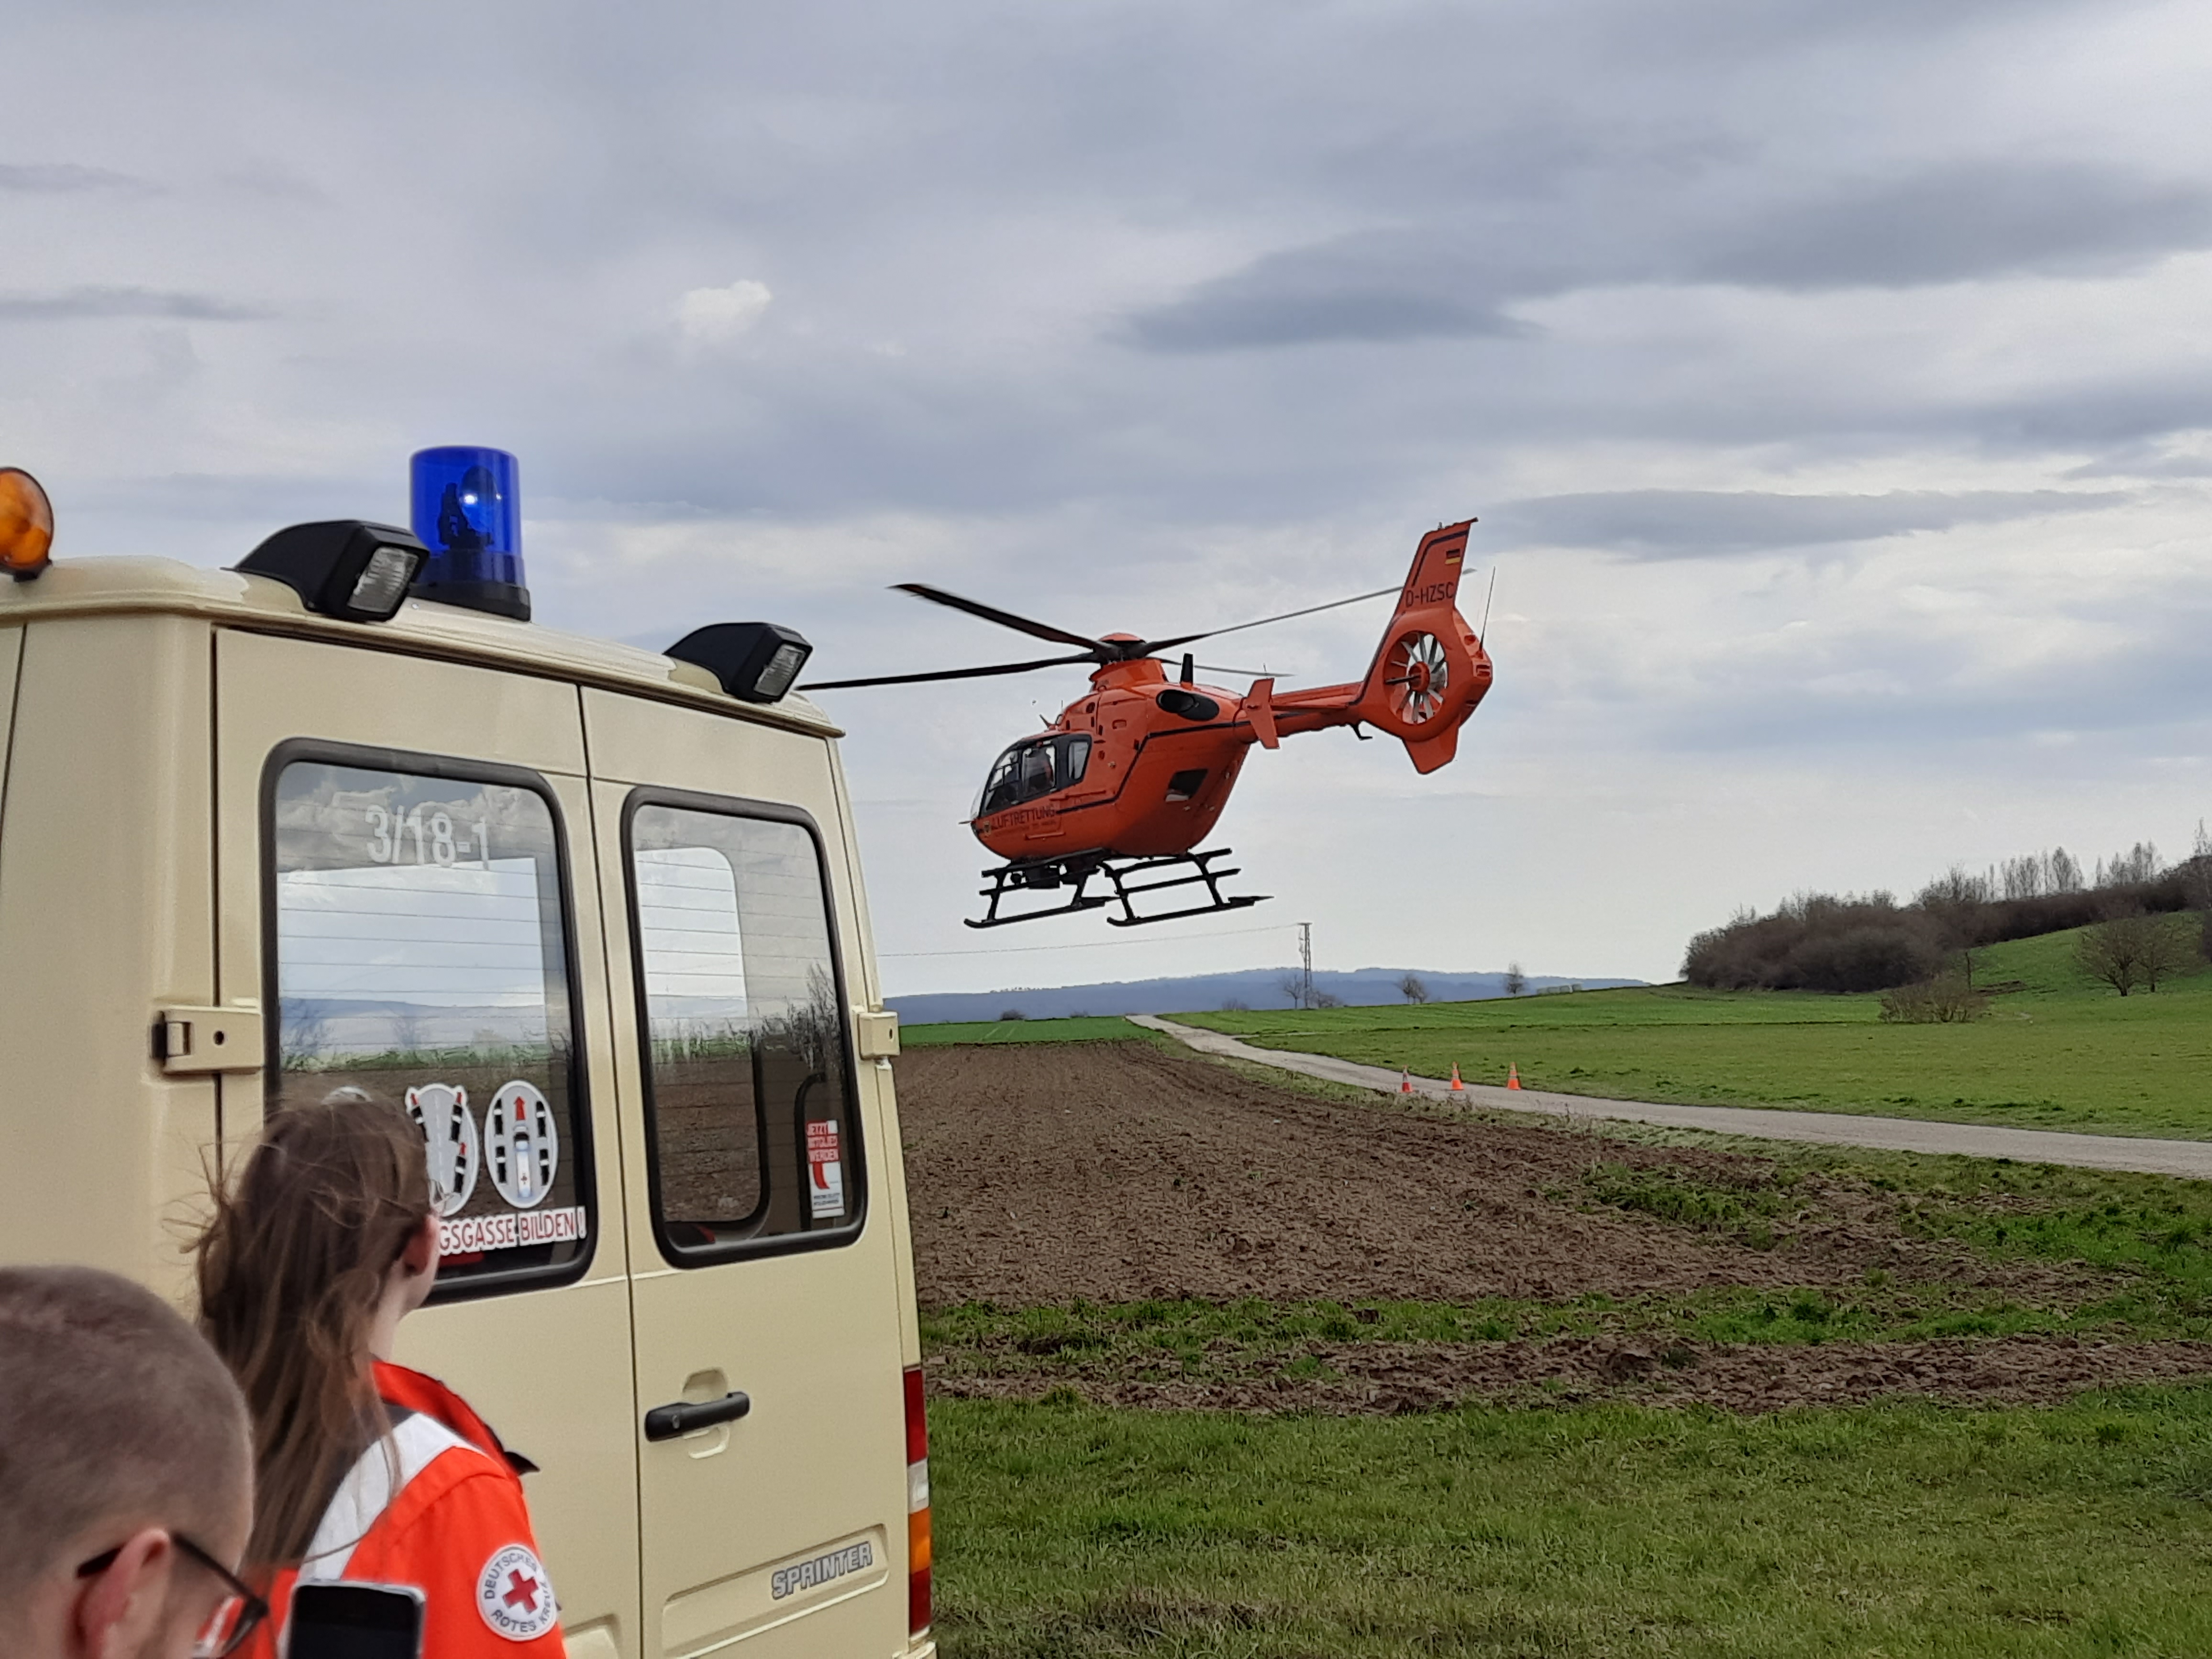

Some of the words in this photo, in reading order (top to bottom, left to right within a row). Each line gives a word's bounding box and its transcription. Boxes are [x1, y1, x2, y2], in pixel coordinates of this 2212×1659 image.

[1405, 582, 1454, 608] D-HZSC
[991, 805, 1056, 830] LUFTRETTUNG
[365, 804, 489, 871] 3/18-1
[439, 1217, 515, 1251] GSGASSE
[771, 1540, 873, 1600] SPRINTER
[491, 1609, 537, 1633] ROTES
